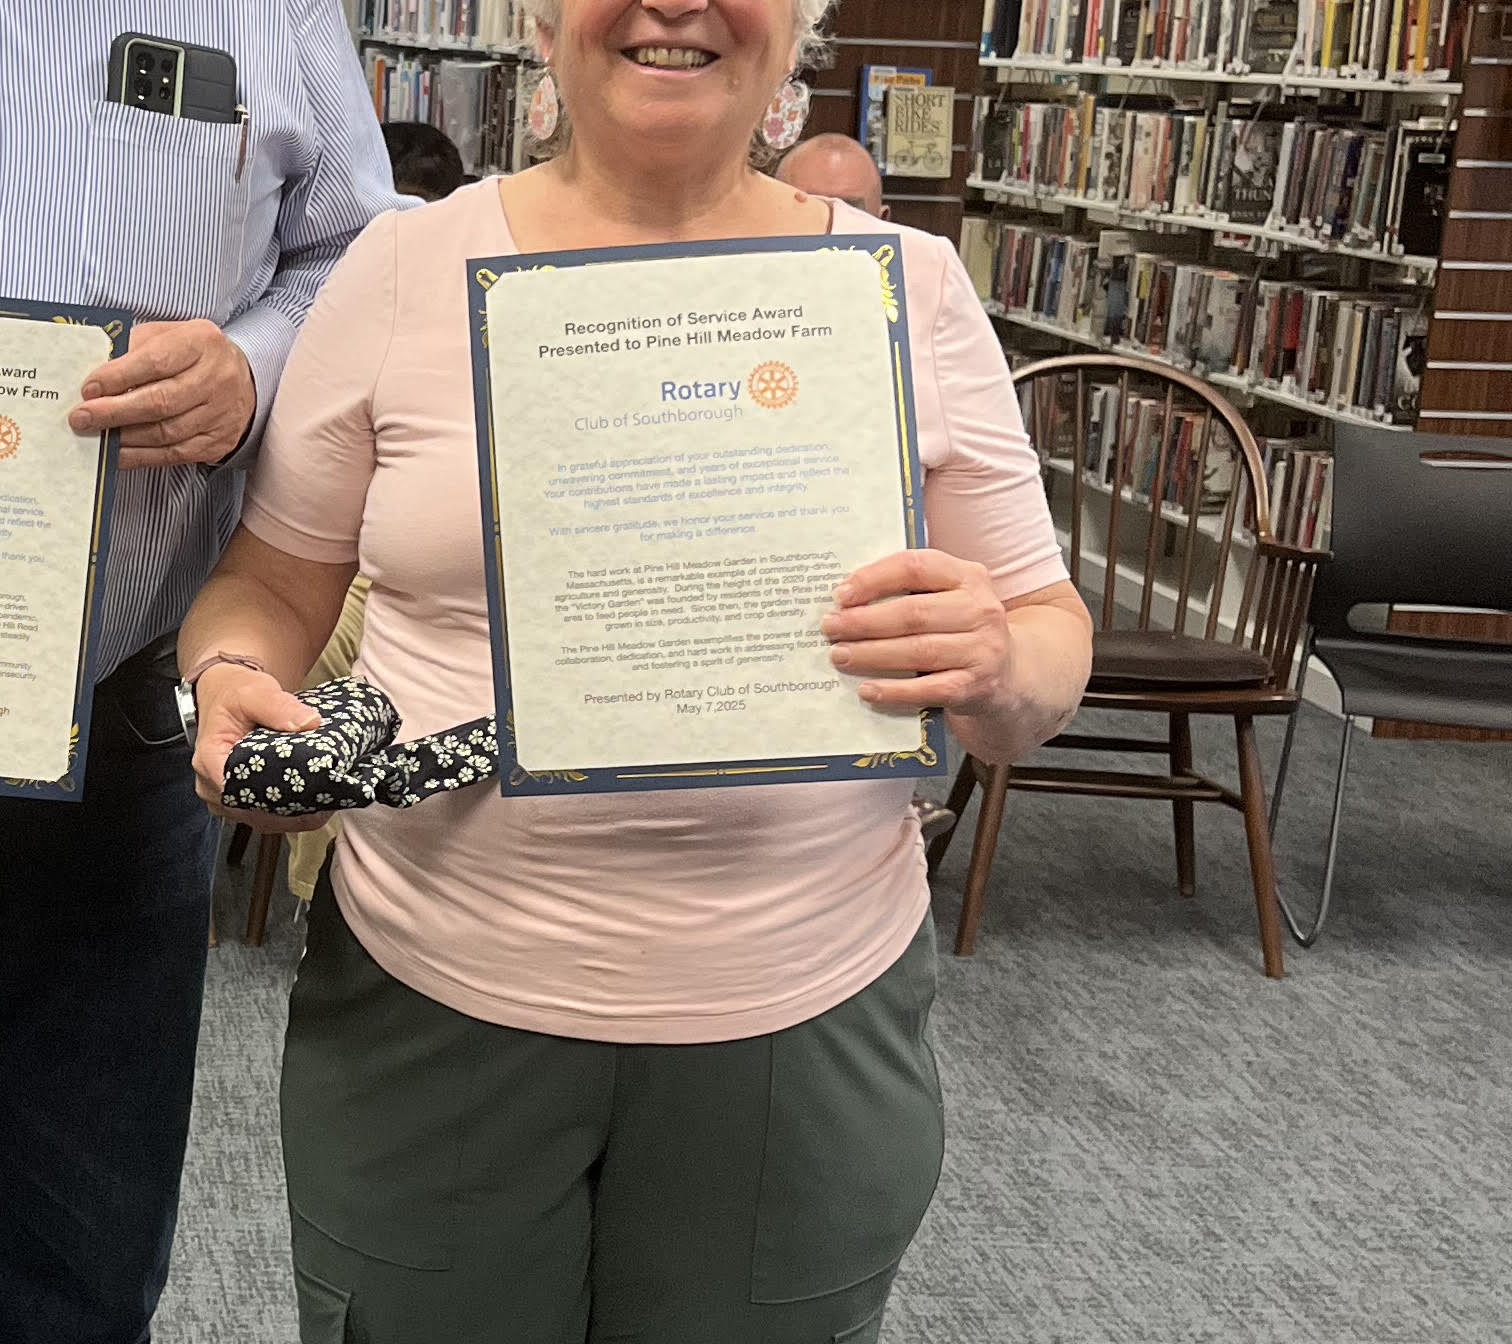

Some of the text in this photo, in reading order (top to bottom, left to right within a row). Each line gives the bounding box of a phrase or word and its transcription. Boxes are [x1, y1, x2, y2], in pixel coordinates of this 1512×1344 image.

[894, 93, 945, 107] SHORT
[895, 104, 931, 119] BIKE
[895, 119, 941, 134] RIDES
[564, 305, 803, 336] Recognition of Service Award
[538, 324, 832, 358] Presented to Pine Hill Meadow Farm
[22, 384, 59, 400] Farm
[660, 379, 741, 402] Rotary
[573, 403, 743, 431] Club of Southborough
[806, 572, 848, 583] pandem
[583, 679, 839, 704] Presented by Rotary Club of Southborough
[676, 702, 702, 715] May
